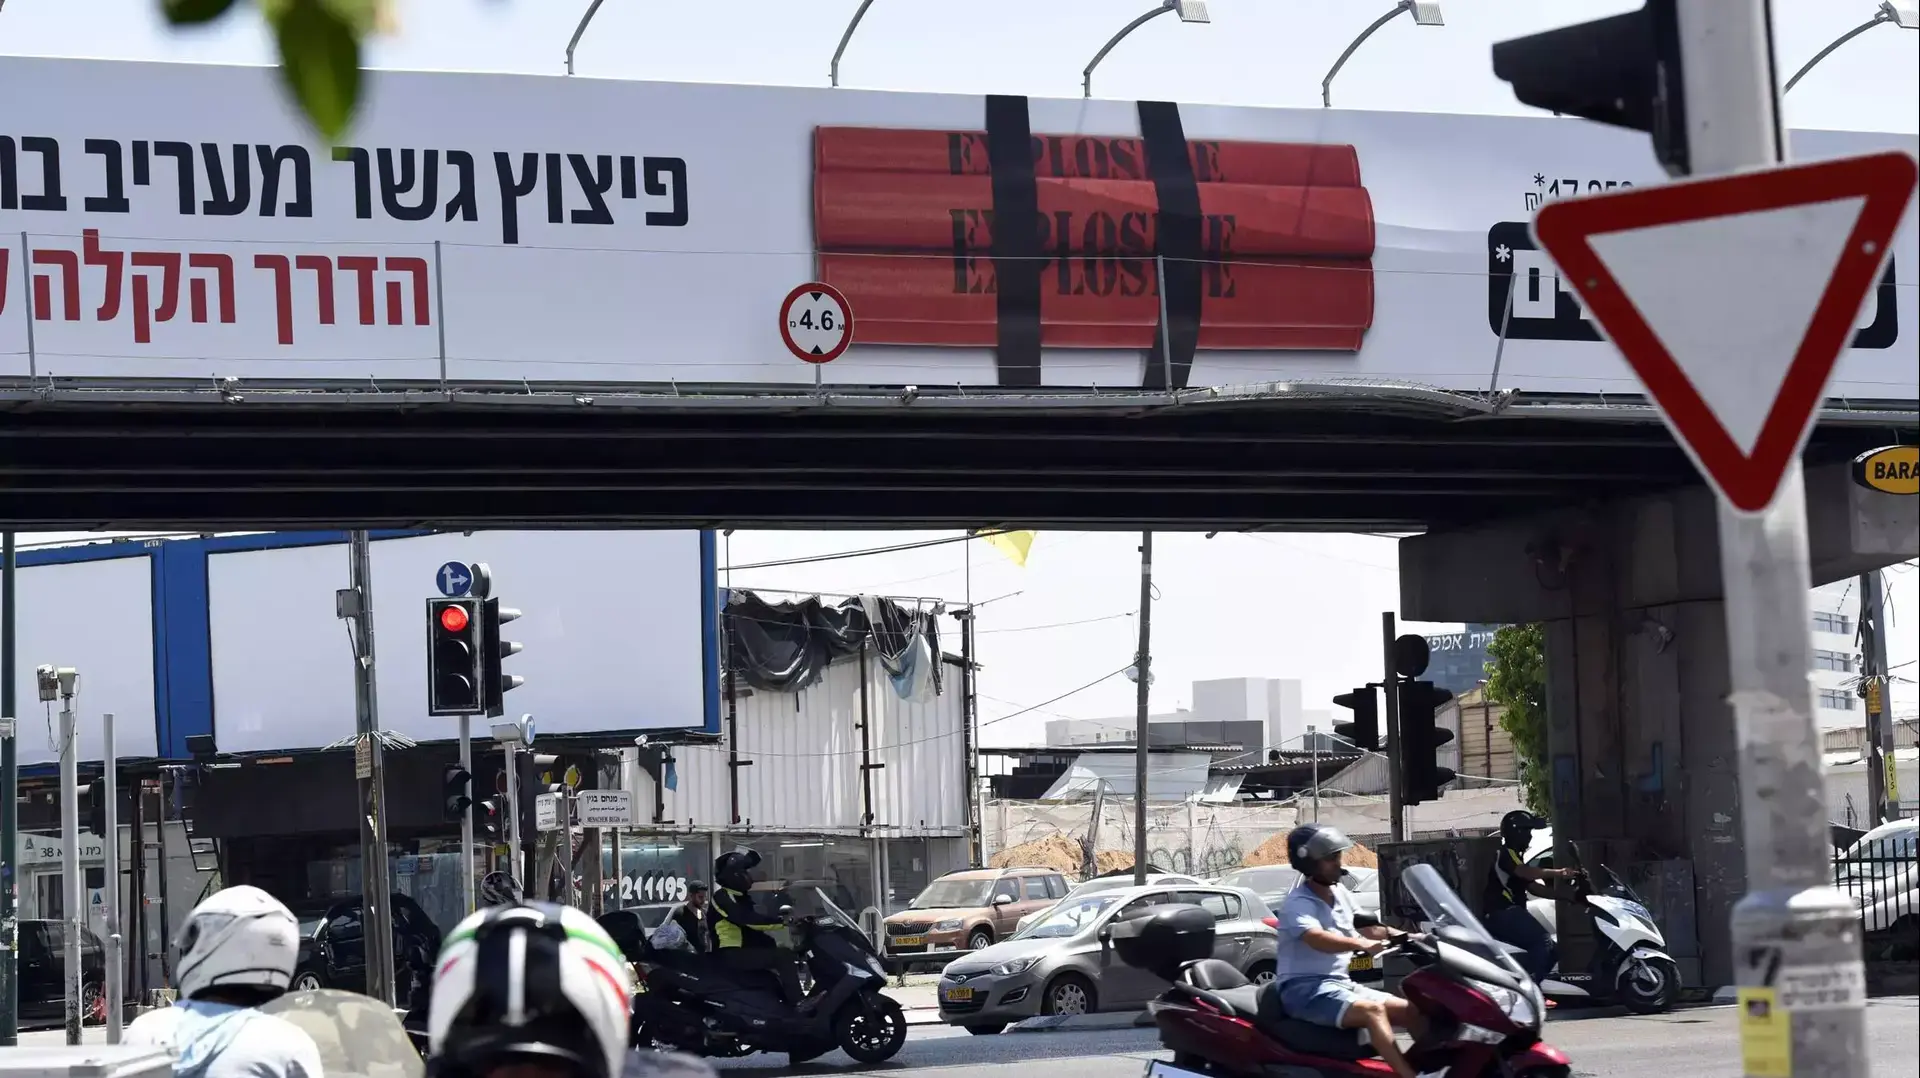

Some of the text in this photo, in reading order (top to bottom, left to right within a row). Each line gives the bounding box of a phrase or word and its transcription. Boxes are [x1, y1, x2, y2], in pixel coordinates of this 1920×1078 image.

[84, 138, 313, 217] מעריב
[331, 146, 478, 223] גשר
[493, 151, 689, 244] פיצוץ
[32, 228, 236, 343] הקלה
[254, 254, 430, 345] הדרך
[799, 308, 834, 331] 4.6
[586, 795, 598, 804] בגין
[600, 795, 618, 803] מנחם
